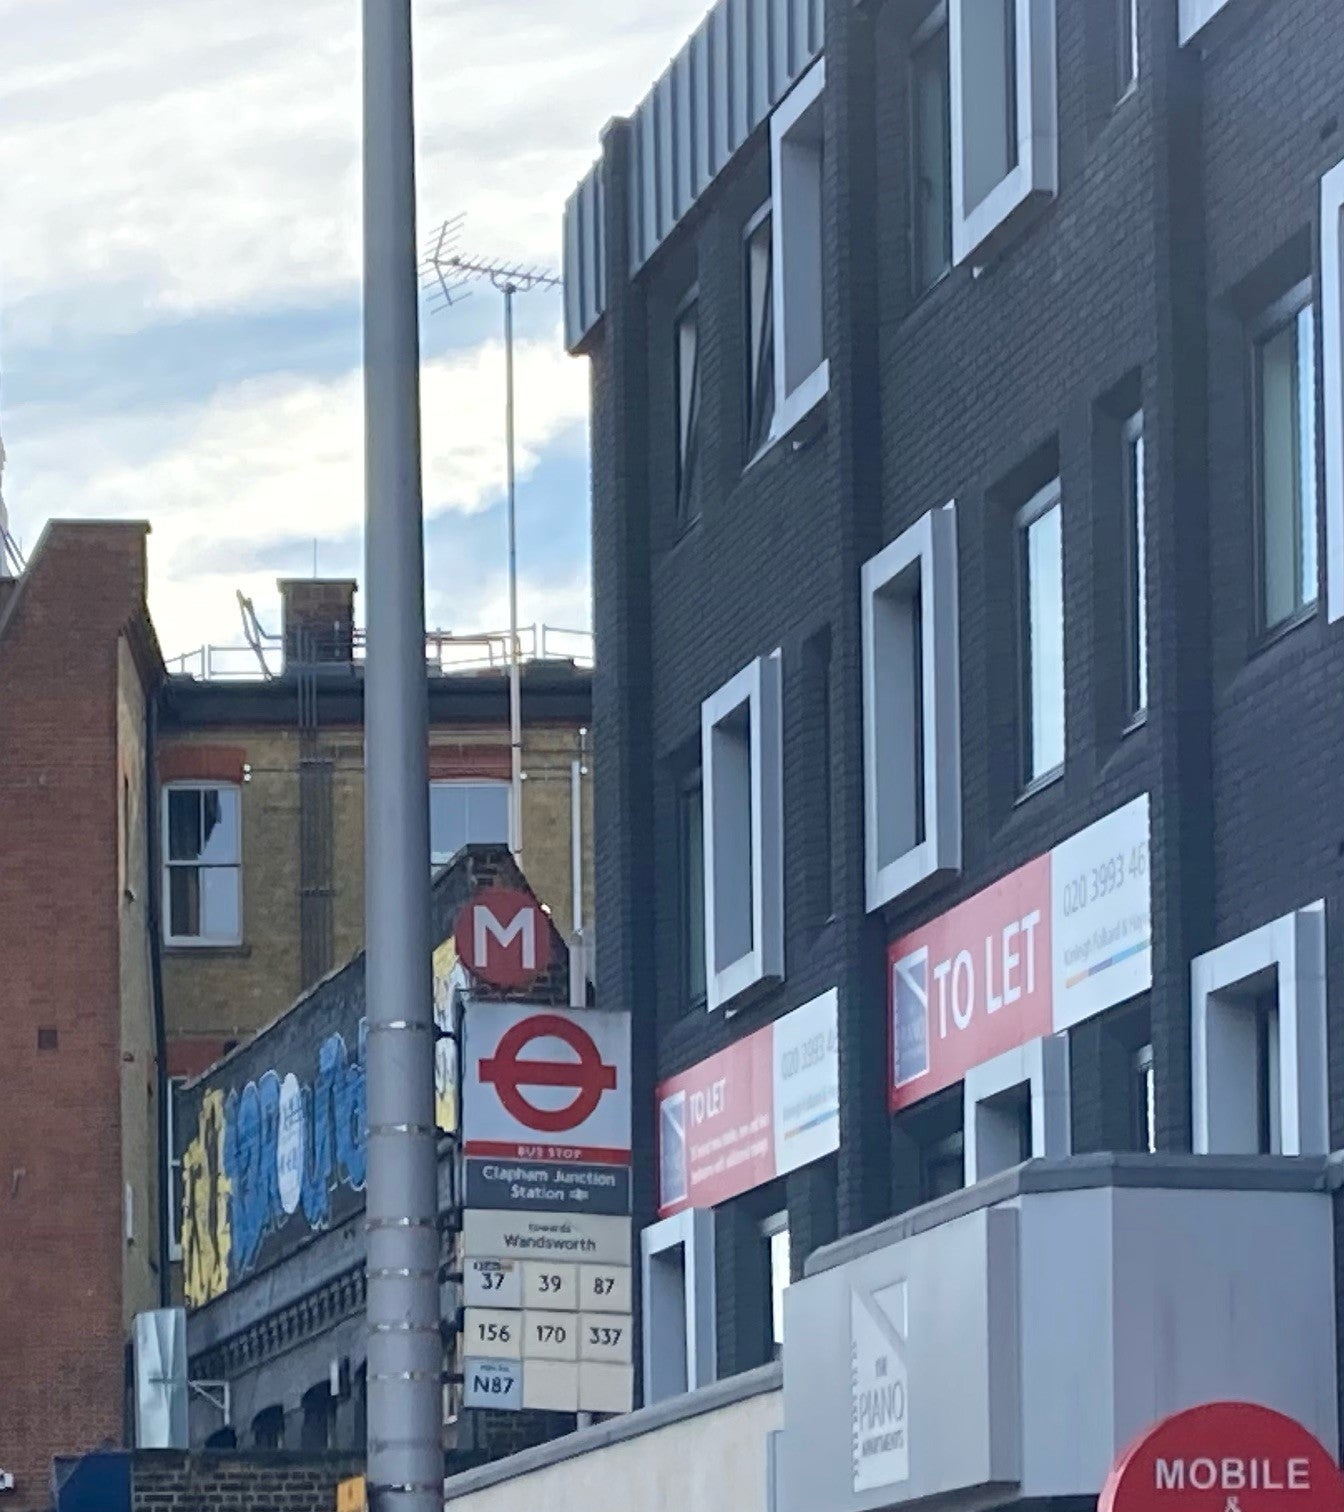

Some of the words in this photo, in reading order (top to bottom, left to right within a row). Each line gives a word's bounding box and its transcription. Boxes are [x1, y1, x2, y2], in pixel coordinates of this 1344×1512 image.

[473, 905, 536, 969] M
[934, 949, 975, 1039] TO
[985, 908, 1041, 1015] LET
[518, 1145, 544, 1158] BUS
[547, 1147, 582, 1160] STOP
[482, 1165, 549, 1183] Clapham
[554, 1169, 616, 1187] Junction
[510, 1183, 564, 1200] Station
[503, 1233, 597, 1252] Wandsworth
[481, 1272, 505, 1290] 37
[538, 1275, 562, 1293] 39
[593, 1278, 615, 1295] 87
[478, 1323, 511, 1343] 156
[536, 1325, 567, 1343] 170
[589, 1327, 623, 1346] 337
[473, 1374, 515, 1394] N87
[859, 1381, 905, 1432] PIANO
[1156, 1458, 1311, 1490] MOBILE
